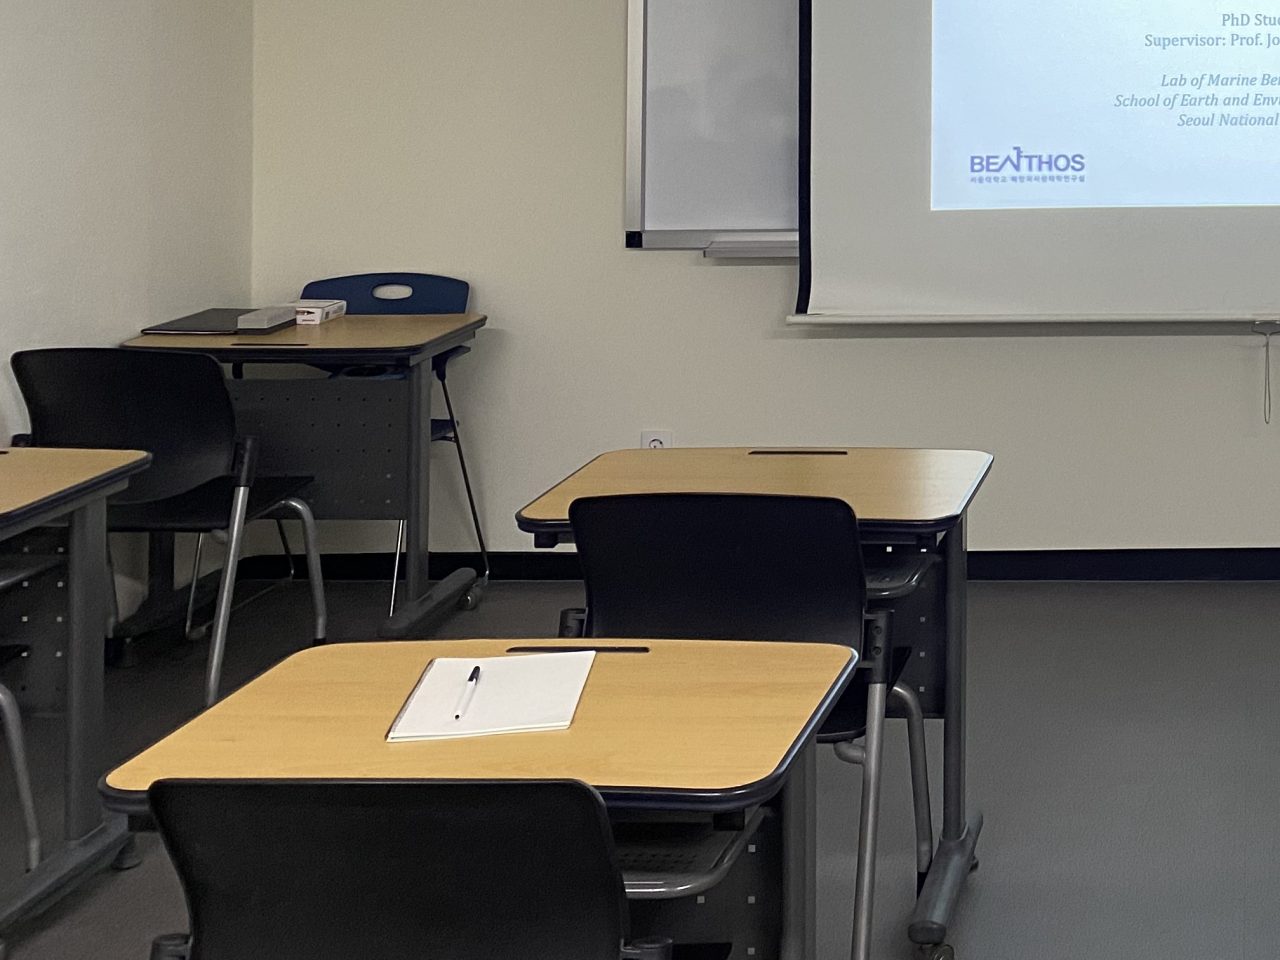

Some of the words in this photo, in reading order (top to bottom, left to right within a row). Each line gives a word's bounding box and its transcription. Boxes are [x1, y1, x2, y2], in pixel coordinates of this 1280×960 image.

[1221, 13, 1250, 26] PhD
[1144, 34, 1226, 50] Supervisor:
[1230, 34, 1263, 47] Prof.
[1161, 73, 1186, 87] Lab
[1190, 73, 1207, 90] of
[1207, 73, 1257, 87] Marine
[1114, 93, 1159, 107] School
[1162, 93, 1179, 111] of
[1180, 93, 1219, 107] Earth
[1222, 93, 1249, 107] and
[1177, 113, 1215, 127] Seoul
[1219, 113, 1279, 127] National
